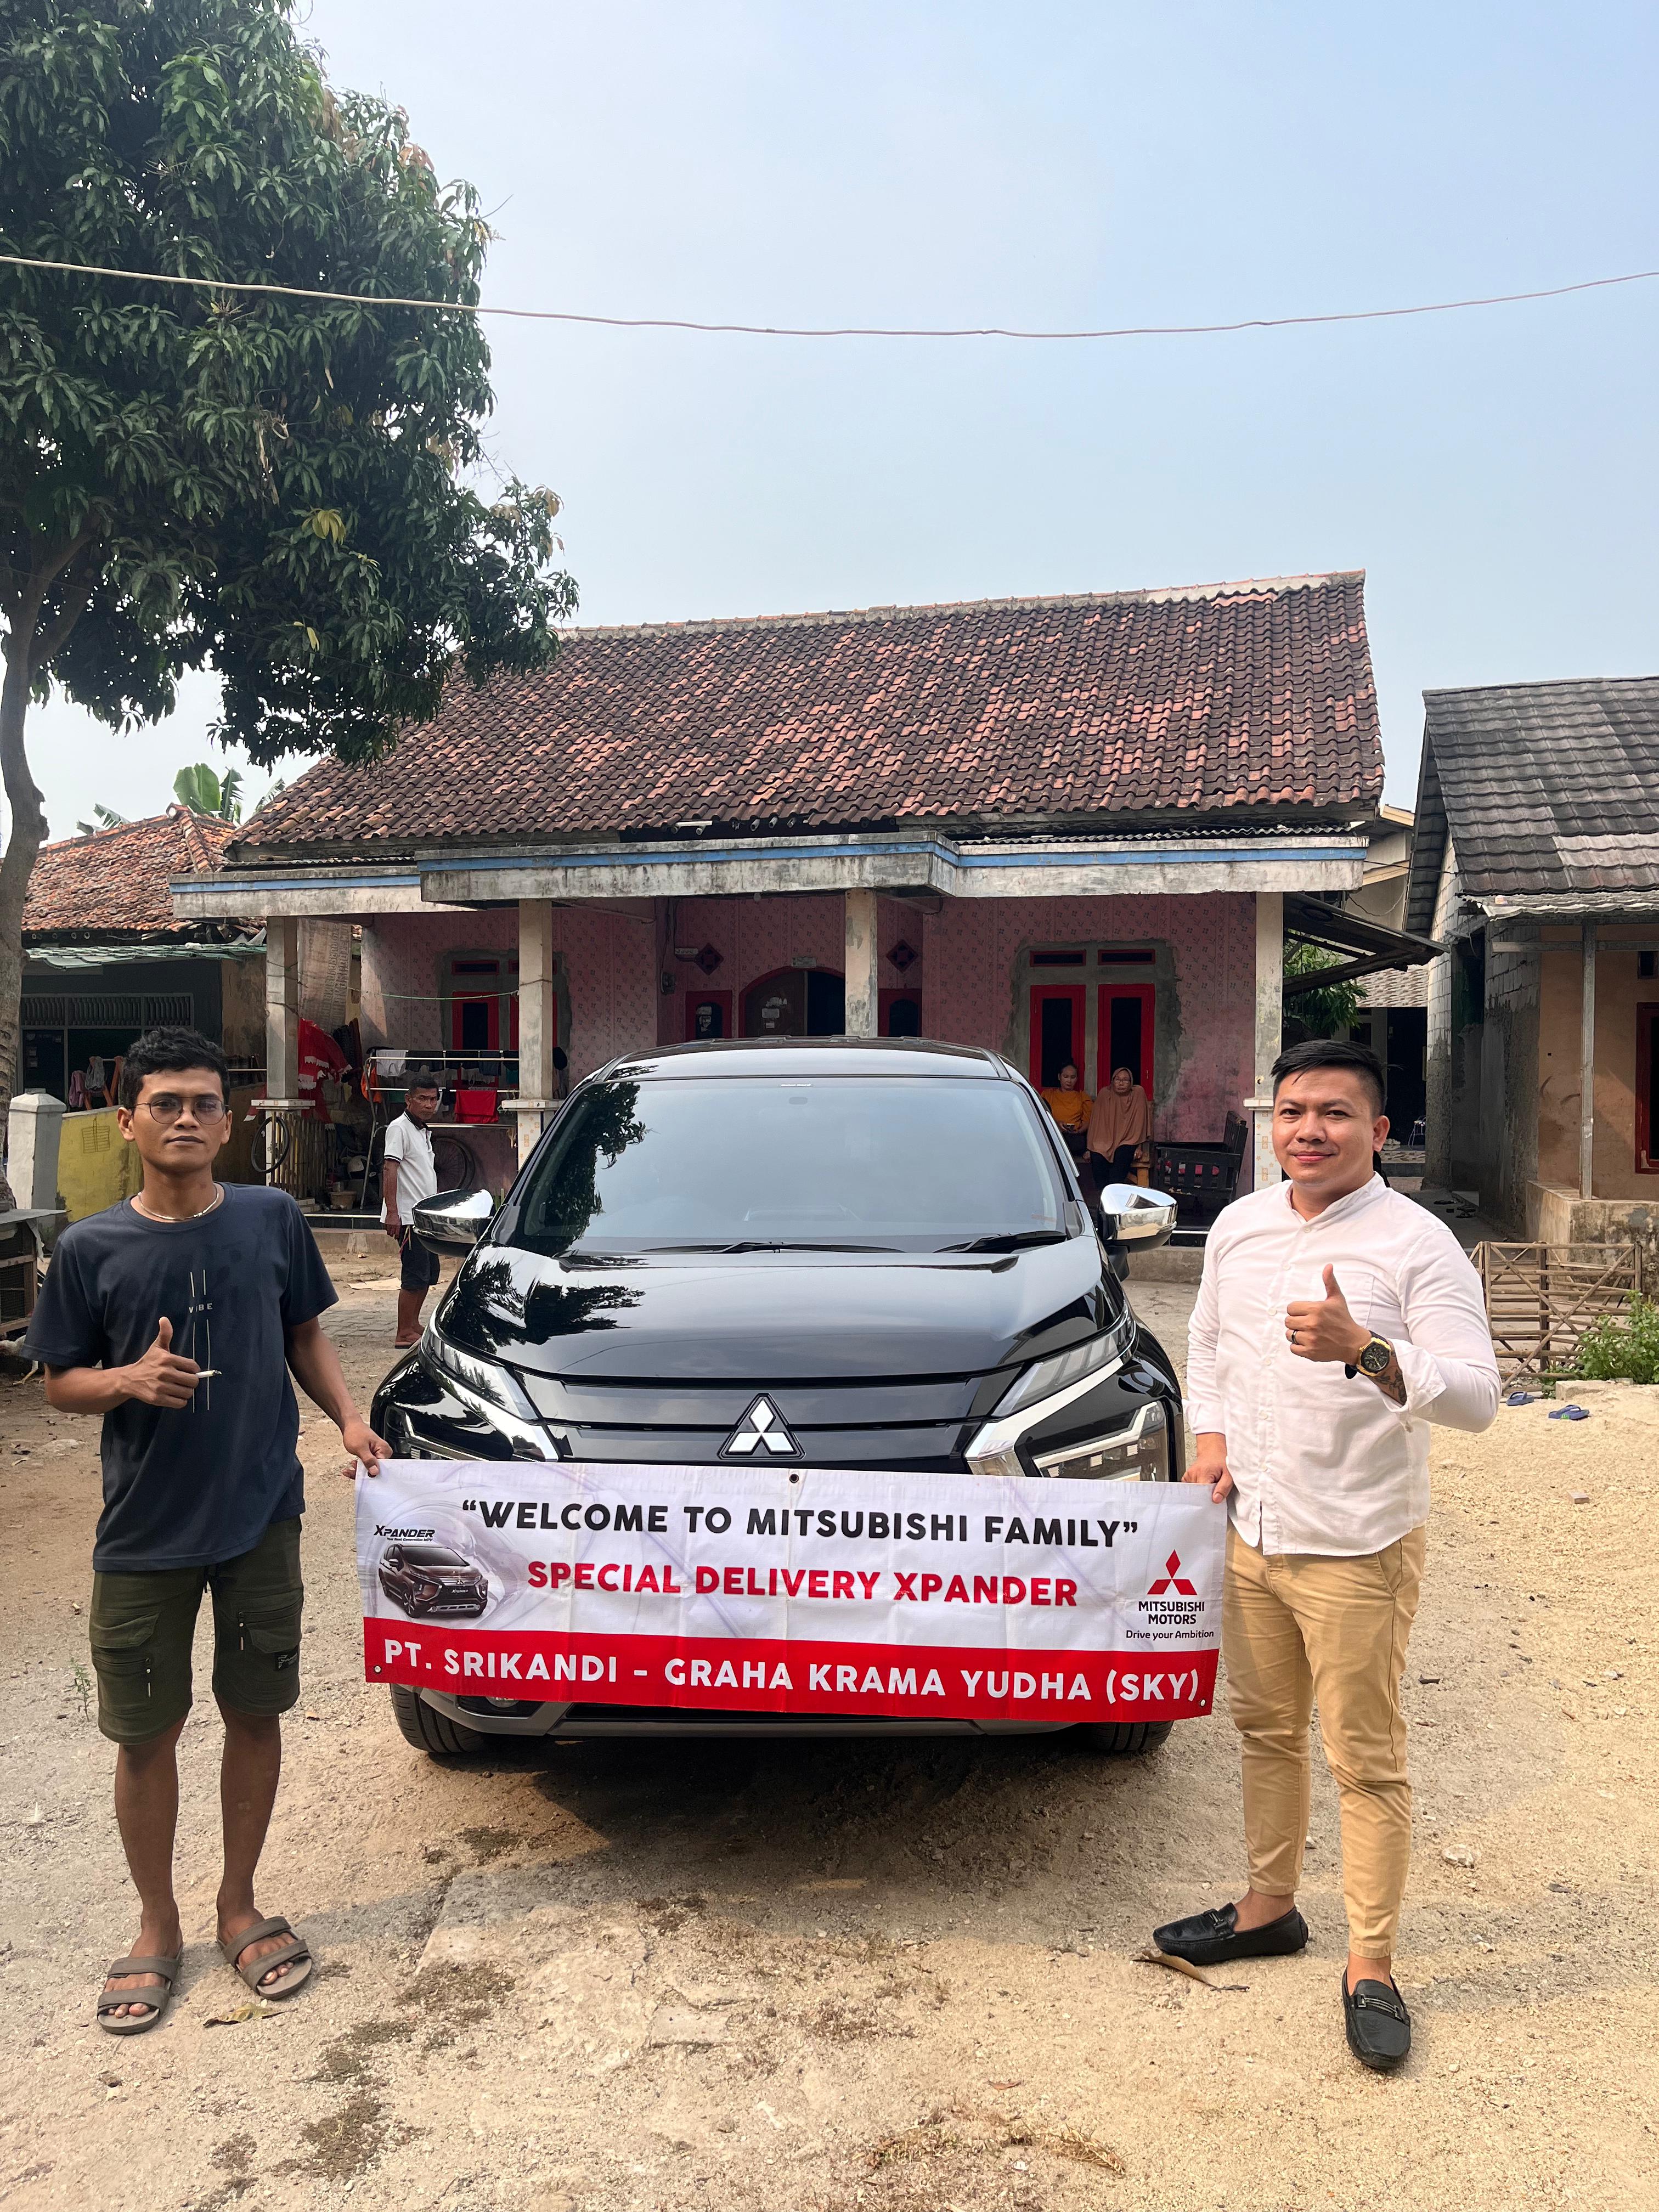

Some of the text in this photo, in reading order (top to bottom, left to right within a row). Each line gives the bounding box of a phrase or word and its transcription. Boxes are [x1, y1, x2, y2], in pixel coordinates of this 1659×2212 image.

[188, 1302, 213, 1313] VIBE
[462, 1499, 1138, 1548] “WELCOME TO MITSUBISHI FAMILY”
[373, 1525, 436, 1538] XPANDER
[528, 1561, 1077, 1606] SPECIAL DELIVERY XPANDER
[1138, 1601, 1205, 1612] MITSUBISHI
[1148, 1614, 1197, 1624] MOTORS
[1126, 1629, 1214, 1641] Drive your Ambition
[385, 1639, 432, 1670] PT.
[444, 1649, 617, 1683] SRIKANDI
[664, 1658, 793, 1690] GRAHA
[809, 1663, 946, 1696] KRAMA
[960, 1669, 1092, 1700] YUDHA
[1106, 1668, 1198, 1704] (SKY)
